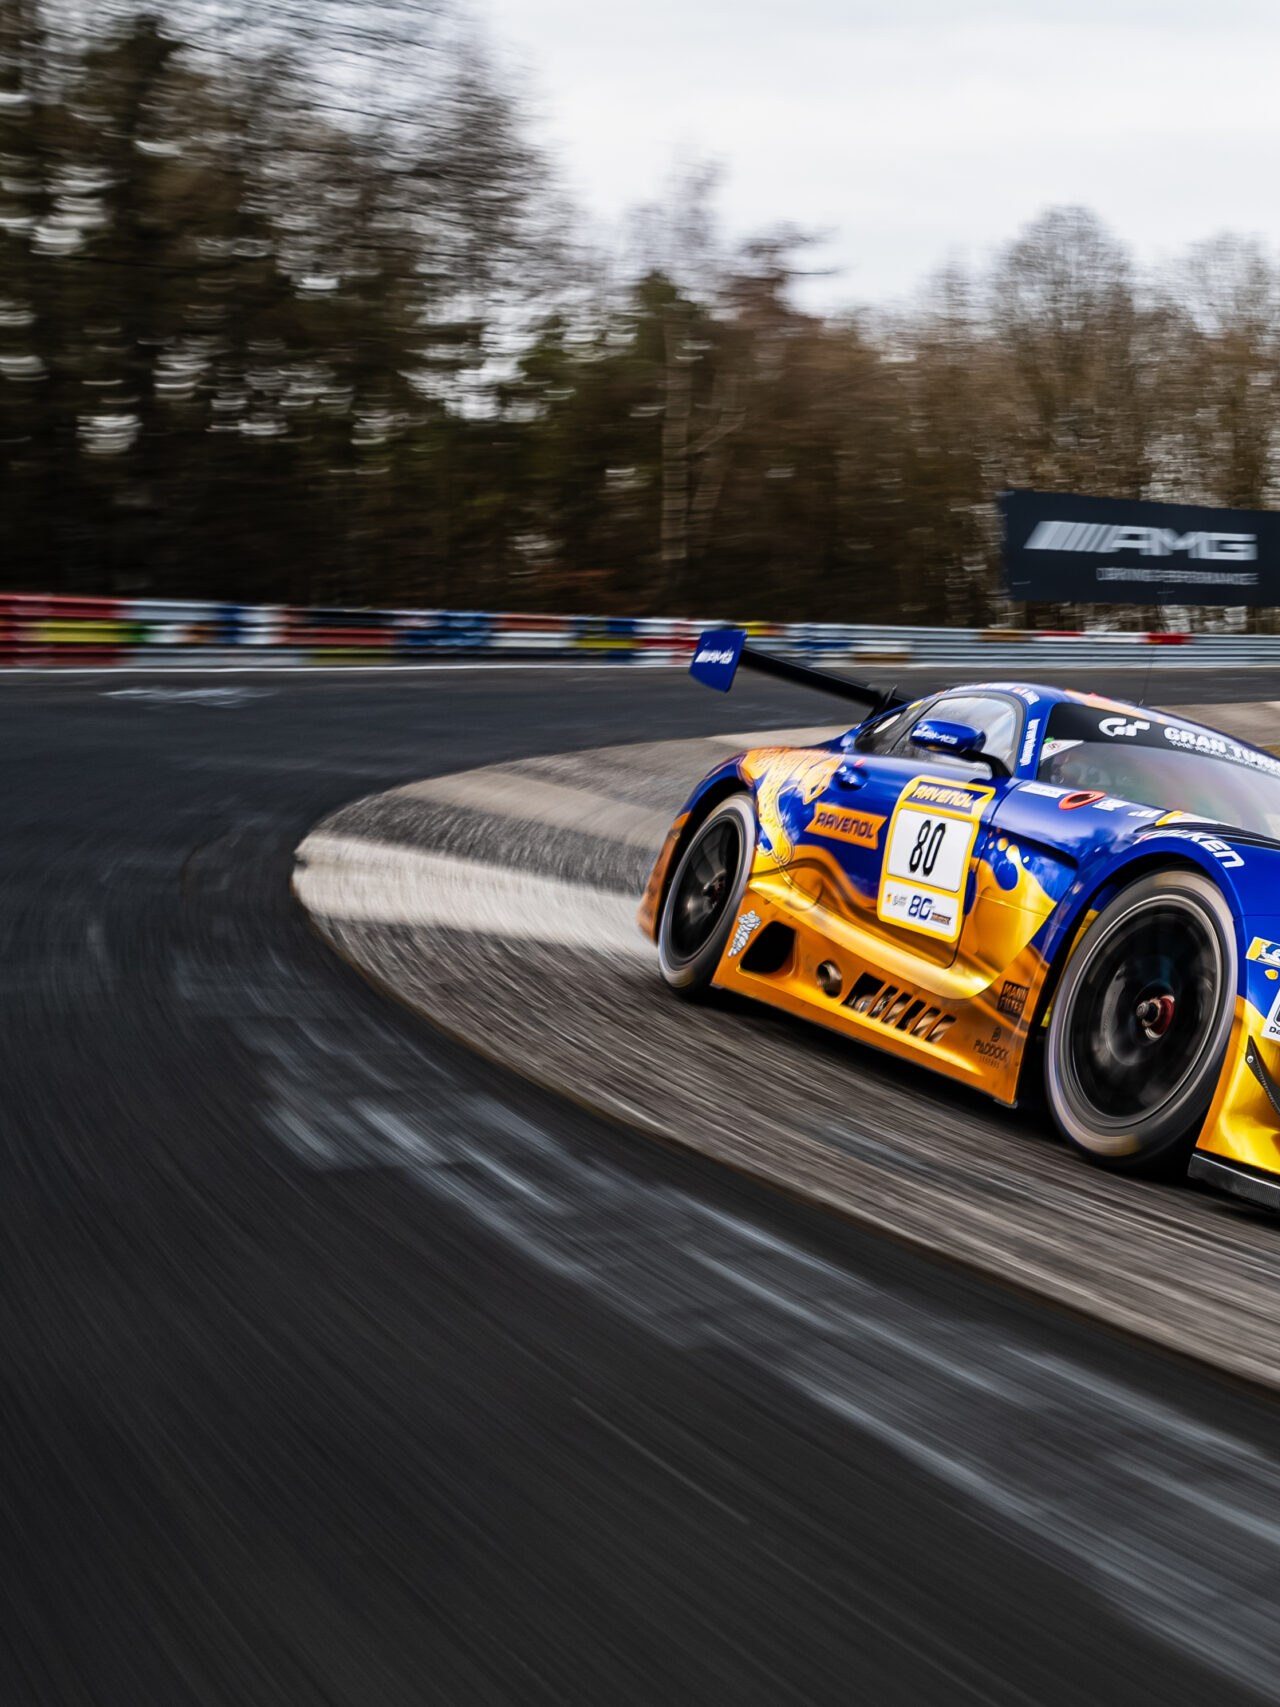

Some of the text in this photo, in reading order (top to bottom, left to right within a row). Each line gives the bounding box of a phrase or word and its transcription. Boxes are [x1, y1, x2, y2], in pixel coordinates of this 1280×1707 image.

[1104, 525, 1258, 560] AMG
[1164, 727, 1226, 754] GRAN
[912, 785, 974, 808] RAVENOL
[815, 811, 874, 839] RAVENOL
[909, 819, 946, 878] 80
